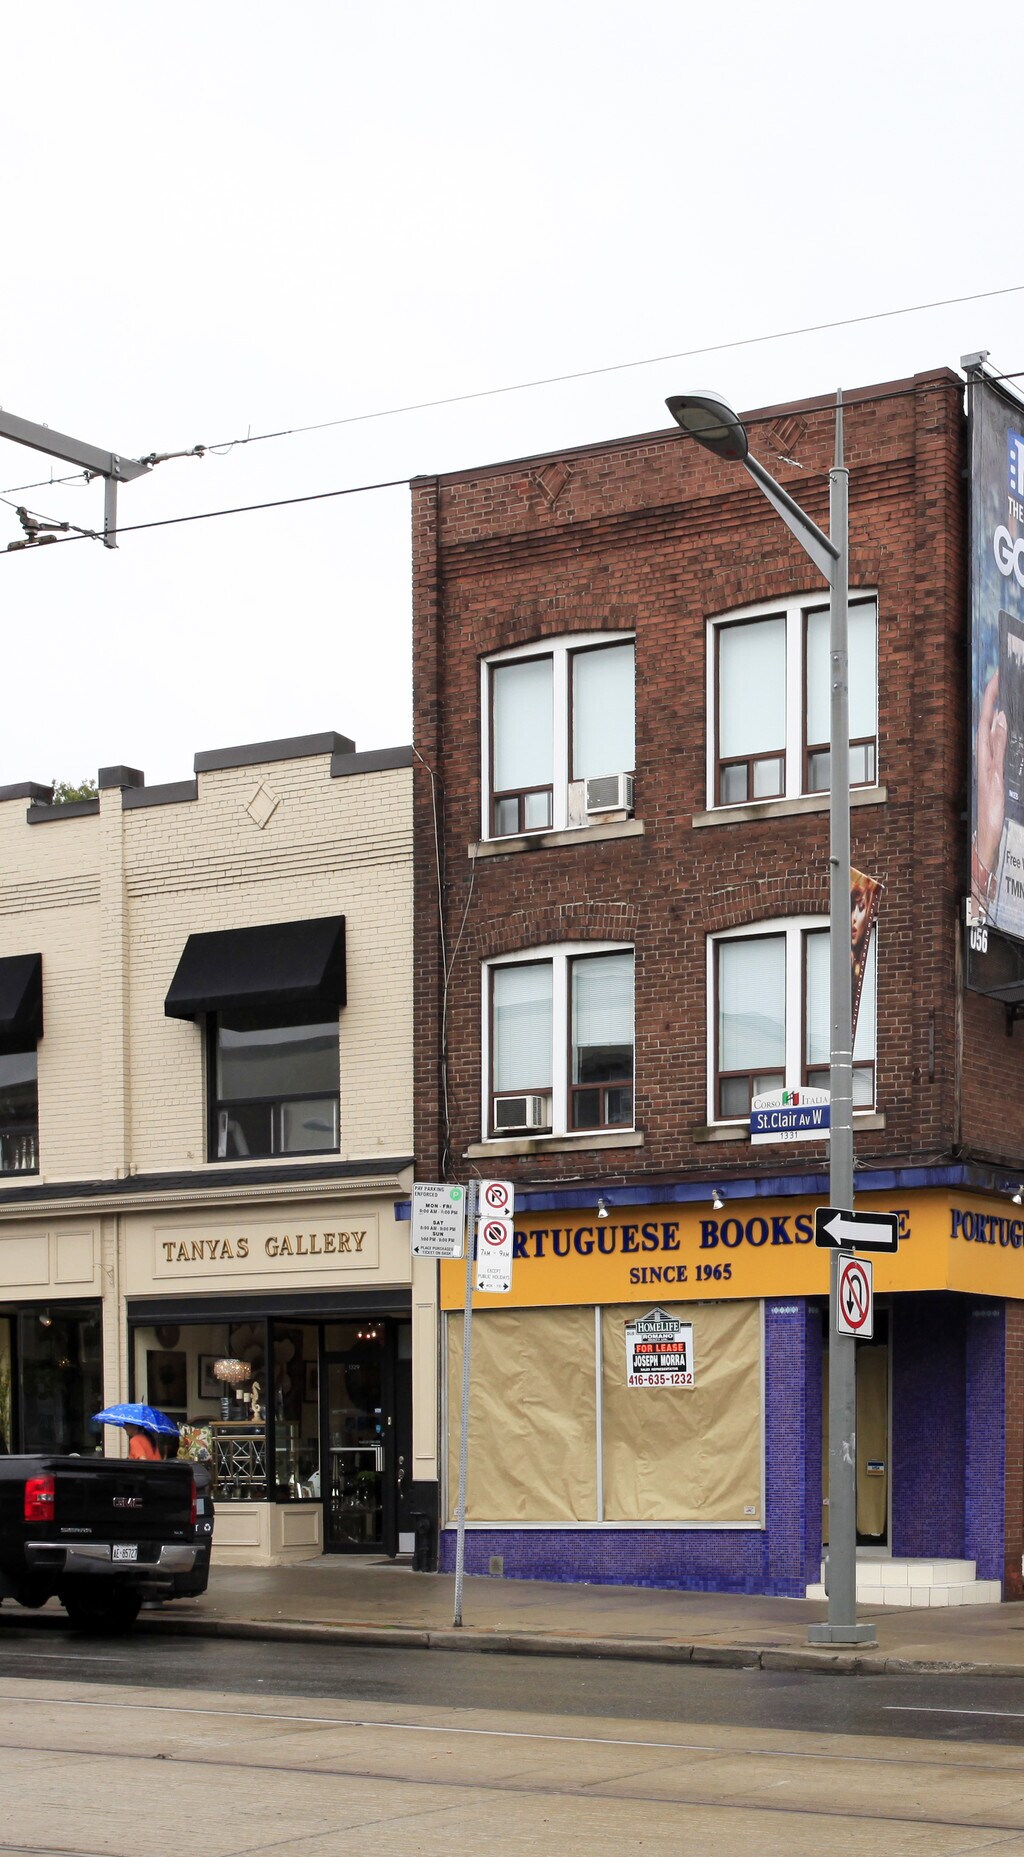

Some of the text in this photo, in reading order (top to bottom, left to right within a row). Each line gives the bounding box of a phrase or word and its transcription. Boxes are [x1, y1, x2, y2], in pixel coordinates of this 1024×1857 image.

[1008, 495, 1024, 524] THE
[1006, 850, 1021, 869] Free
[799, 1114, 810, 1126] Av
[812, 1109, 822, 1124] W
[780, 1131, 798, 1140] 1331
[473, 1210, 911, 1260] RTUGUESE BOOKSE
[162, 1231, 367, 1262] TANYAS GALLERY
[629, 1263, 732, 1285] SINCE 1965
[636, 1343, 684, 1352] FOR LEASE
[633, 1354, 685, 1367] JOSEPH MORRA
[629, 1373, 692, 1385] 416-635-1232
[112, 1497, 143, 1508] GMC
